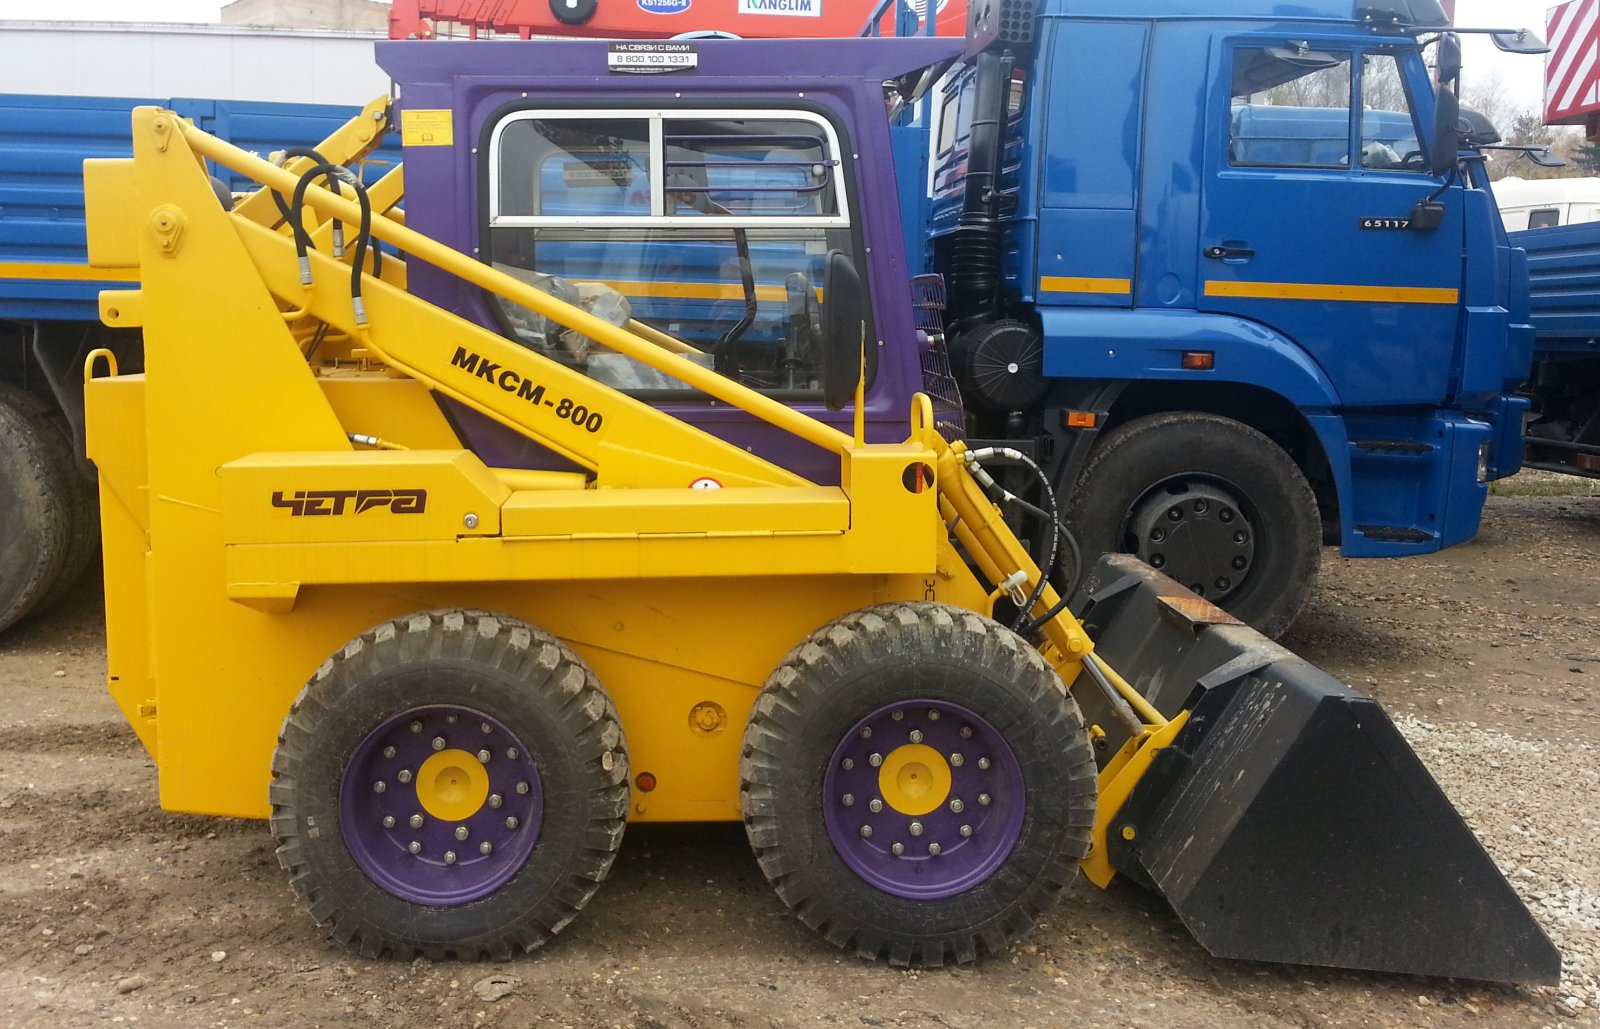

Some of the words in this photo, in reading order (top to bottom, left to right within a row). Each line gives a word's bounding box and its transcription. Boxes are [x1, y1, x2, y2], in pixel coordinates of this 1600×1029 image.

[747, 0, 812, 11] KANGLIM
[616, 55, 623, 63] 8
[625, 55, 645, 63] 800
[648, 55, 665, 63] 100
[667, 55, 690, 63] 1331
[1364, 220, 1409, 228] 65117
[450, 346, 603, 433] МКСМ-800
[271, 489, 428, 517] ЧЕТРА
